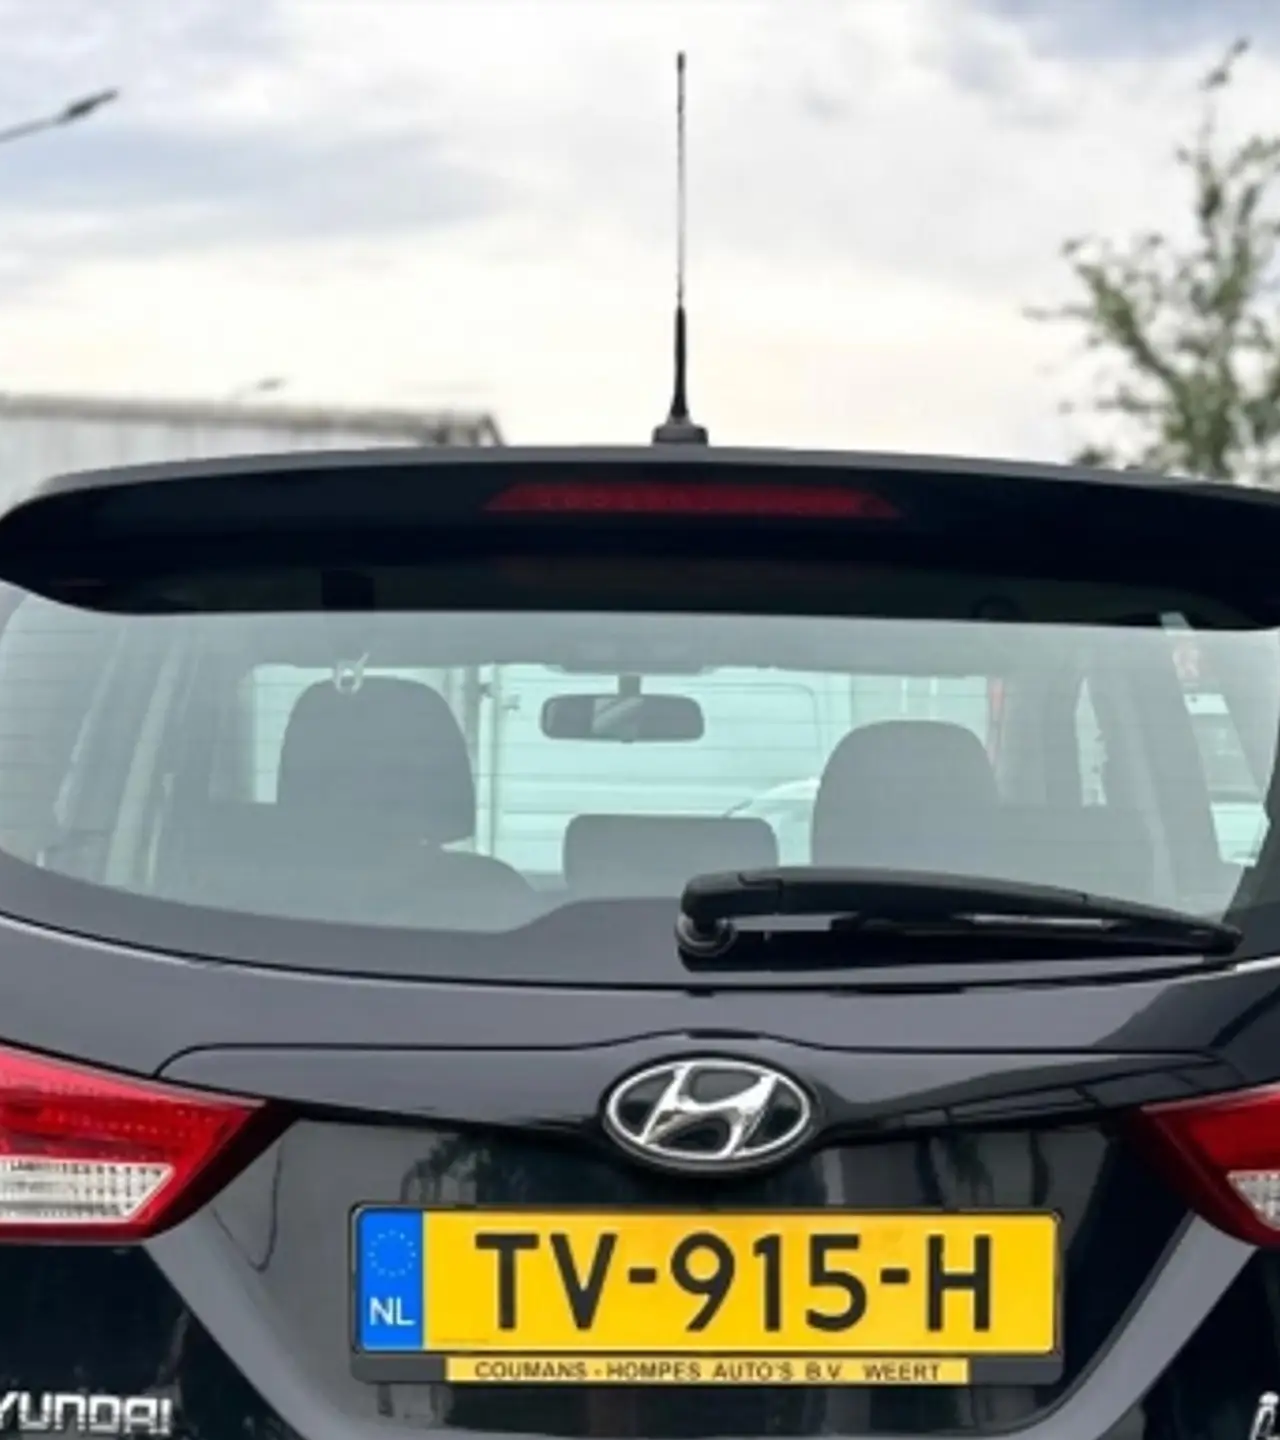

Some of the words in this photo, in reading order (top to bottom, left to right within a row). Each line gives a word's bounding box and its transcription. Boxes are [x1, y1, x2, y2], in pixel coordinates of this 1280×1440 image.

[369, 1299, 414, 1327] NL
[474, 1232, 992, 1333] TV-915-H
[713, 1361, 794, 1381] AUTO'S
[862, 1361, 941, 1381] WEERT
